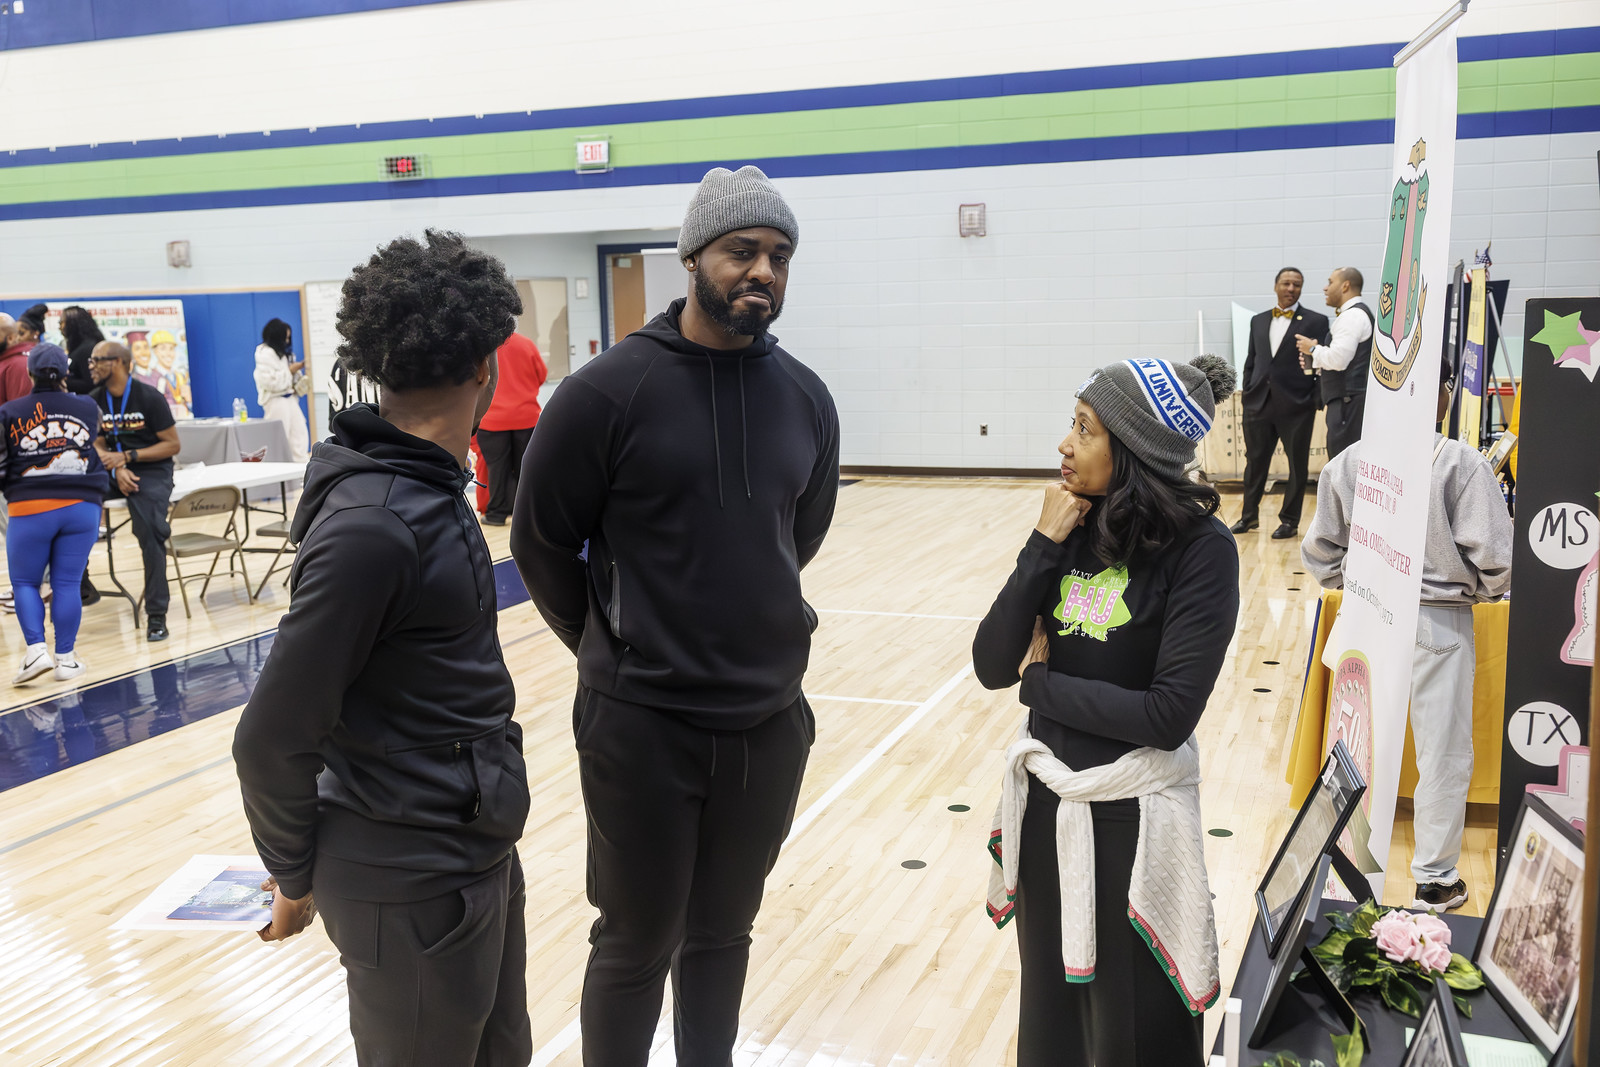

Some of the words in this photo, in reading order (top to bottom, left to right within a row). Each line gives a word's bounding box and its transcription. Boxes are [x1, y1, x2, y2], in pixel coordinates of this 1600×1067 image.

[584, 143, 602, 162] EXIT
[10, 401, 48, 447] Hail
[20, 421, 90, 452] STATE
[1539, 507, 1591, 549] MS
[1062, 581, 1121, 625] HU
[1518, 709, 1572, 746] TX
